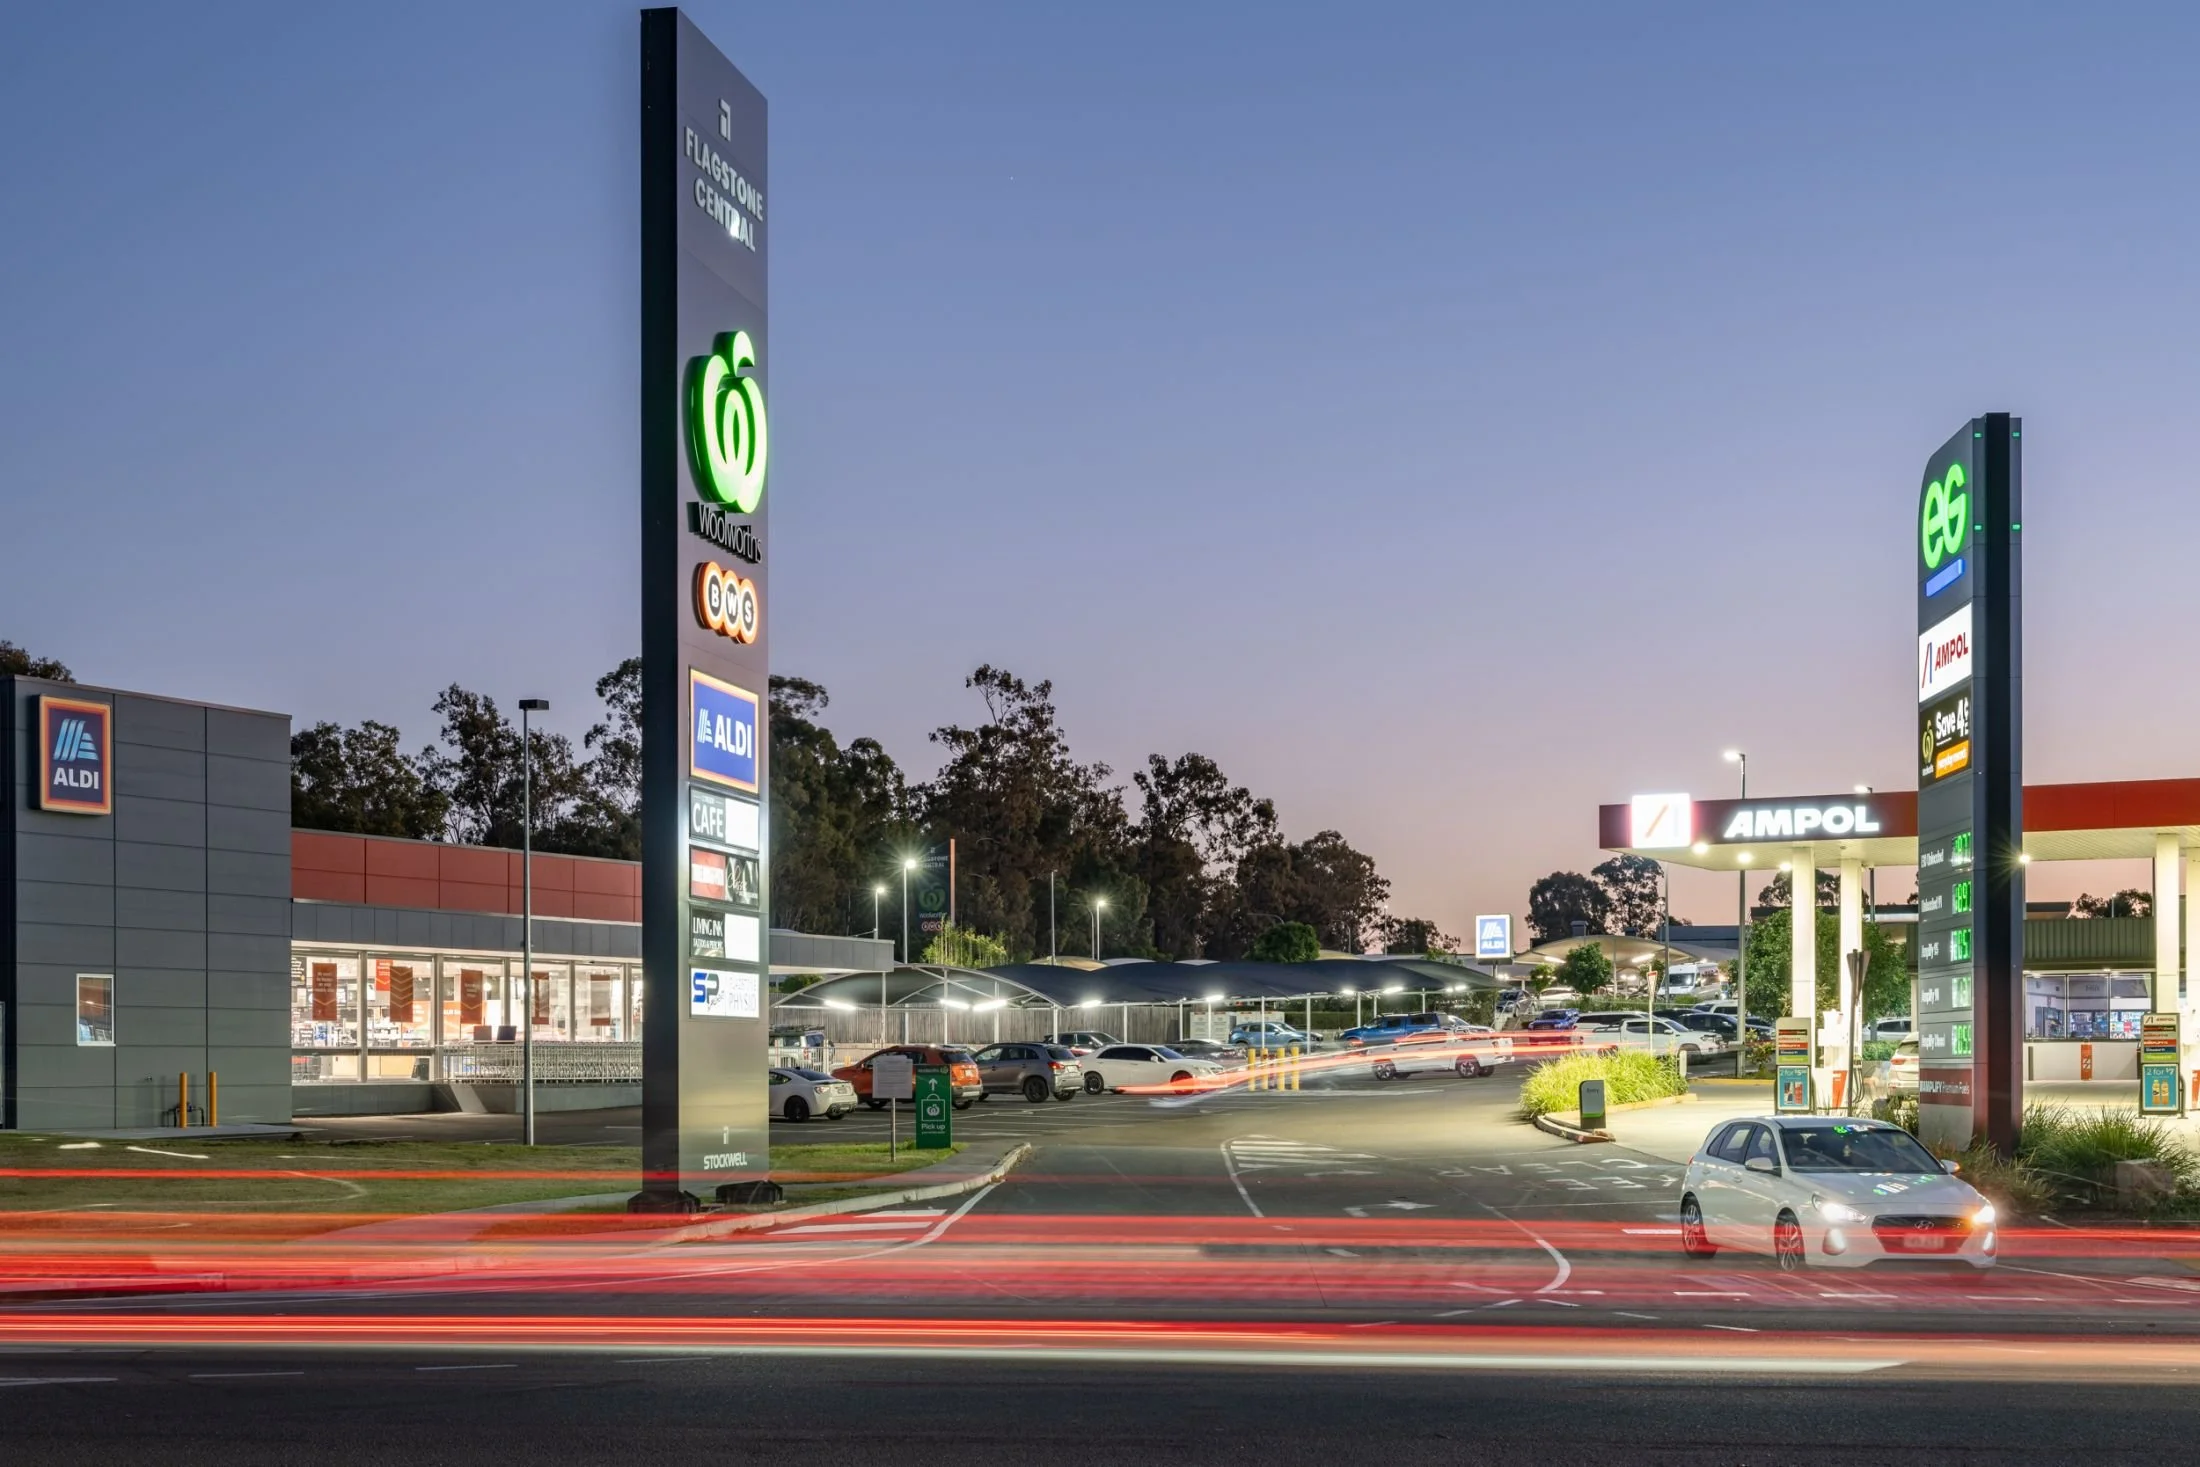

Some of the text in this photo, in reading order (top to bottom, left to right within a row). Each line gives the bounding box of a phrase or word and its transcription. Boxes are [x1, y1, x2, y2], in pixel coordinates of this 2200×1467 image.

[685, 126, 763, 222] FLAGSTONE
[694, 178, 756, 252] CENTRAL
[698, 504, 762, 563] Woolworths
[711, 584, 752, 623] BWS
[1935, 632, 1968, 671] AMPOL
[714, 714, 753, 759] ALDI
[1936, 711, 1956, 739] Save
[53, 767, 99, 789] ALDI
[692, 802, 724, 838] CAFE
[1723, 806, 1880, 838] AMPOL
[1481, 940, 1504, 950] ALDI
[2146, 1067, 2152, 1075] 2
[2153, 1067, 2164, 1075] for
[936, 1124, 946, 1132] up
